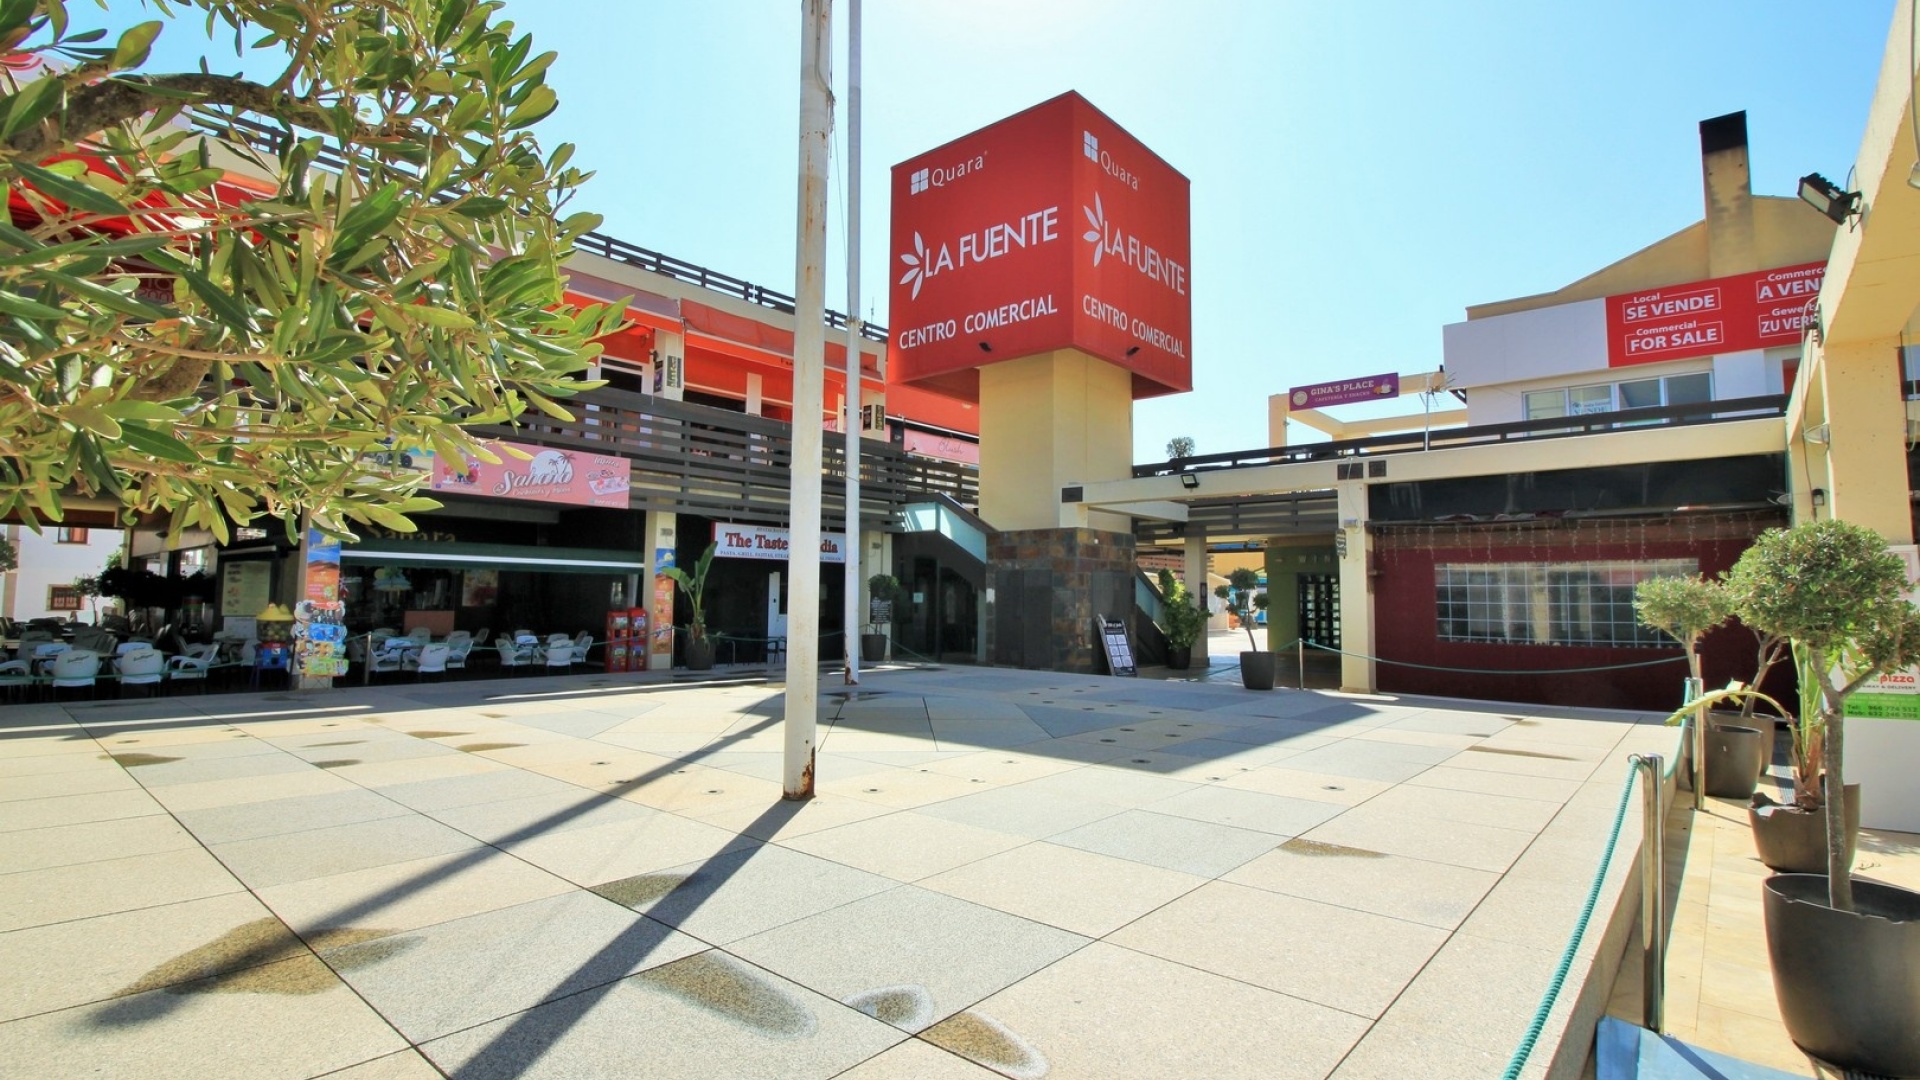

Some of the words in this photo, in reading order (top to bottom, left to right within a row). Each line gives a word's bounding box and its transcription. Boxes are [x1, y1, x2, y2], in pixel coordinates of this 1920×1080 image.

[932, 155, 984, 187] Quara
[1100, 150, 1139, 192] Quara
[925, 242, 953, 279] LA
[959, 206, 1058, 267] FUENTE
[1103, 220, 1126, 264] LA
[1127, 234, 1185, 296] FUENTE
[1633, 292, 1660, 304] Local
[1759, 285, 1773, 299] A
[1777, 276, 1824, 296] VEN
[1626, 306, 1647, 320] SE
[1651, 294, 1715, 316] VENDE
[899, 319, 957, 350] CENTRO
[964, 294, 1058, 334] COMERCIAL
[1082, 295, 1128, 332] CENTRO
[1131, 318, 1185, 359] COMERCIAL
[1636, 320, 1697, 336] Commercial
[1761, 320, 1780, 334] ZU
[1630, 335, 1667, 352] FOR
[1671, 328, 1718, 346] SALE
[1311, 385, 1341, 395] GINA'S
[1343, 380, 1375, 392] PLACE
[493, 468, 573, 496] Sahara
[725, 532, 752, 548] The
[755, 534, 789, 551] Taste
[820, 539, 838, 554] dia
